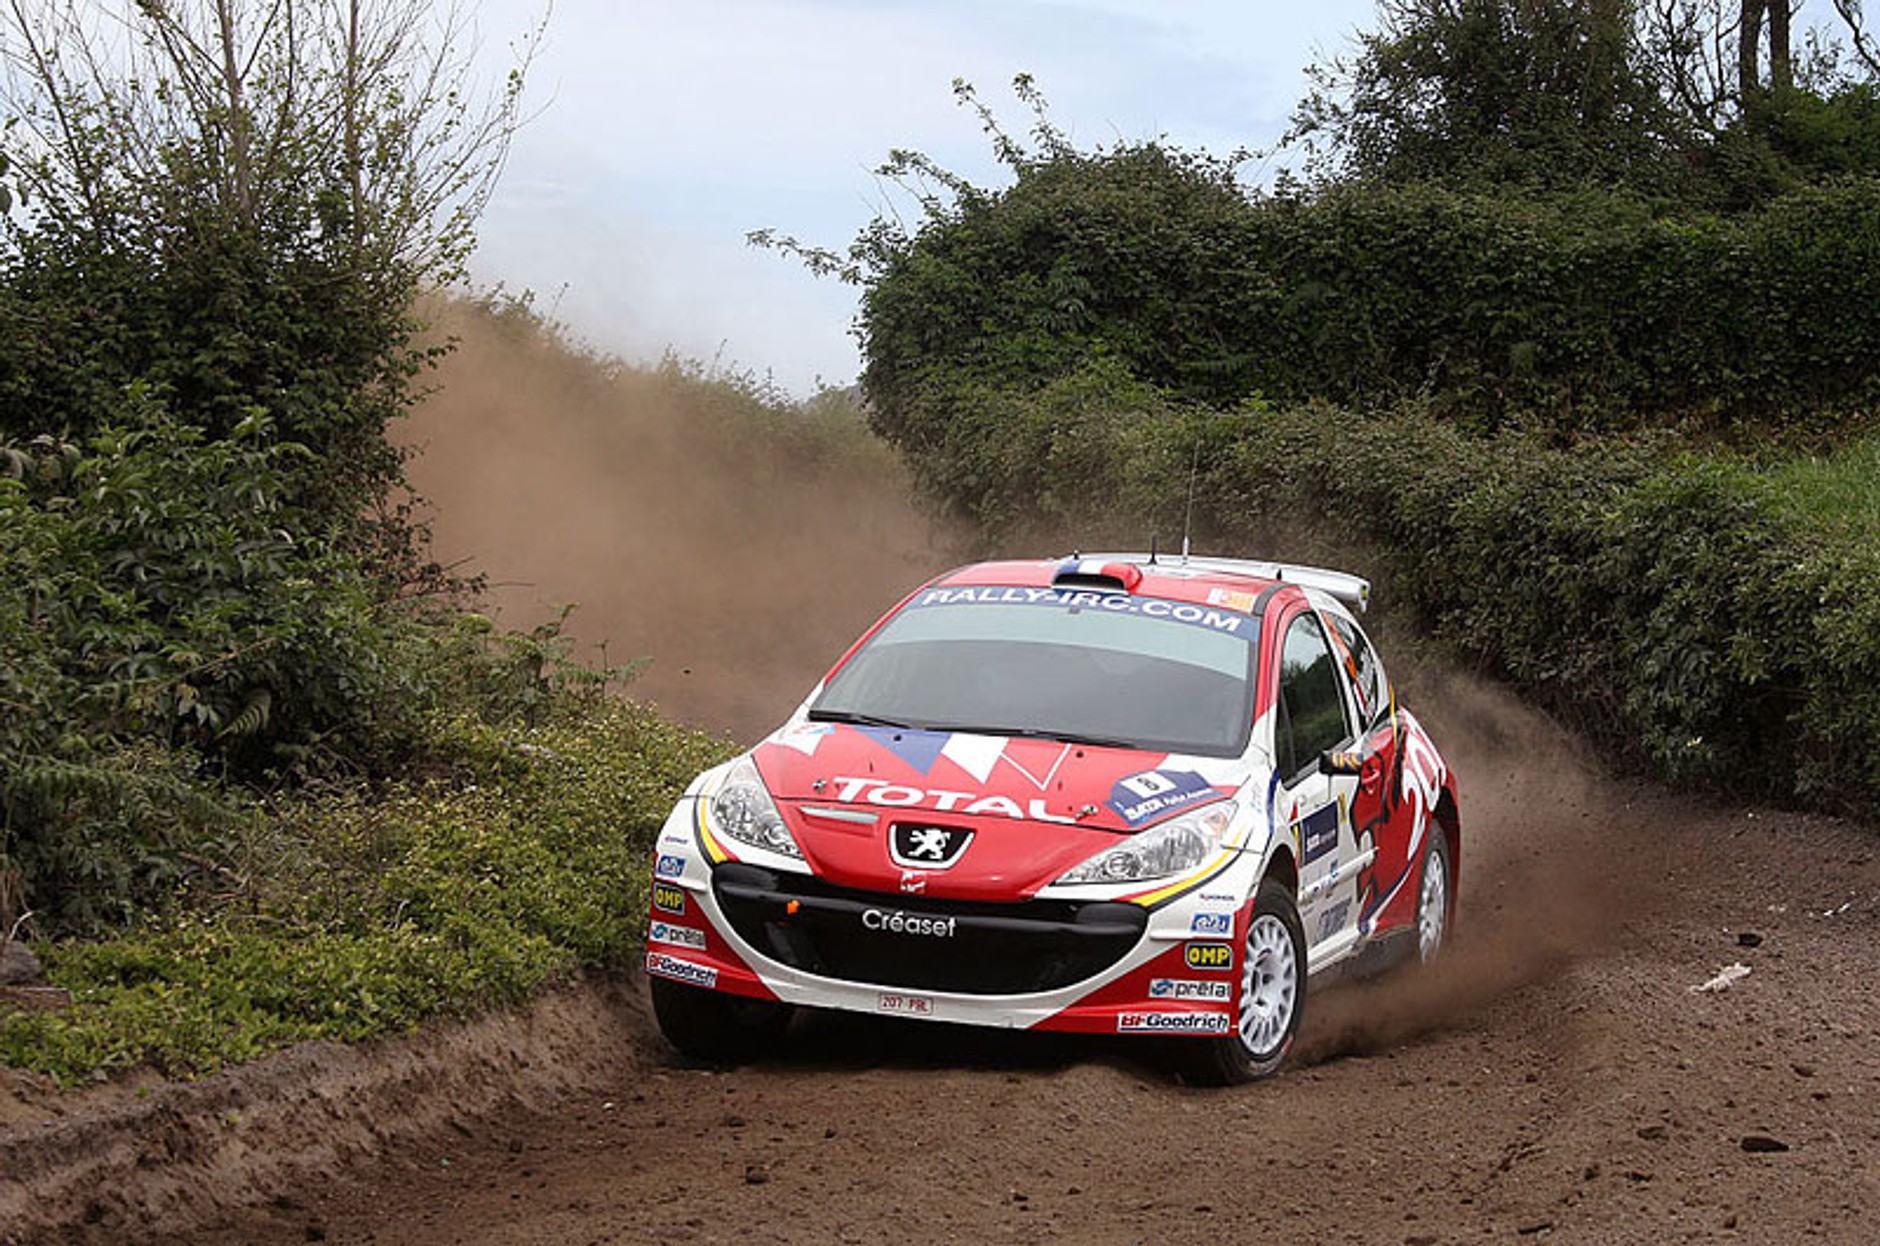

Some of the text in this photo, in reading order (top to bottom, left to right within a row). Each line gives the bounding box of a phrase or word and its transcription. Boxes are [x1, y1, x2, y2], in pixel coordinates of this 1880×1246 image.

[833, 776, 1077, 824] TOTAL
[656, 890, 682, 908] OMP
[862, 909, 956, 937] Créaset
[1189, 948, 1229, 965] OMP
[883, 996, 903, 1008] 207
[1121, 1013, 1229, 1028] BFGoodrich
